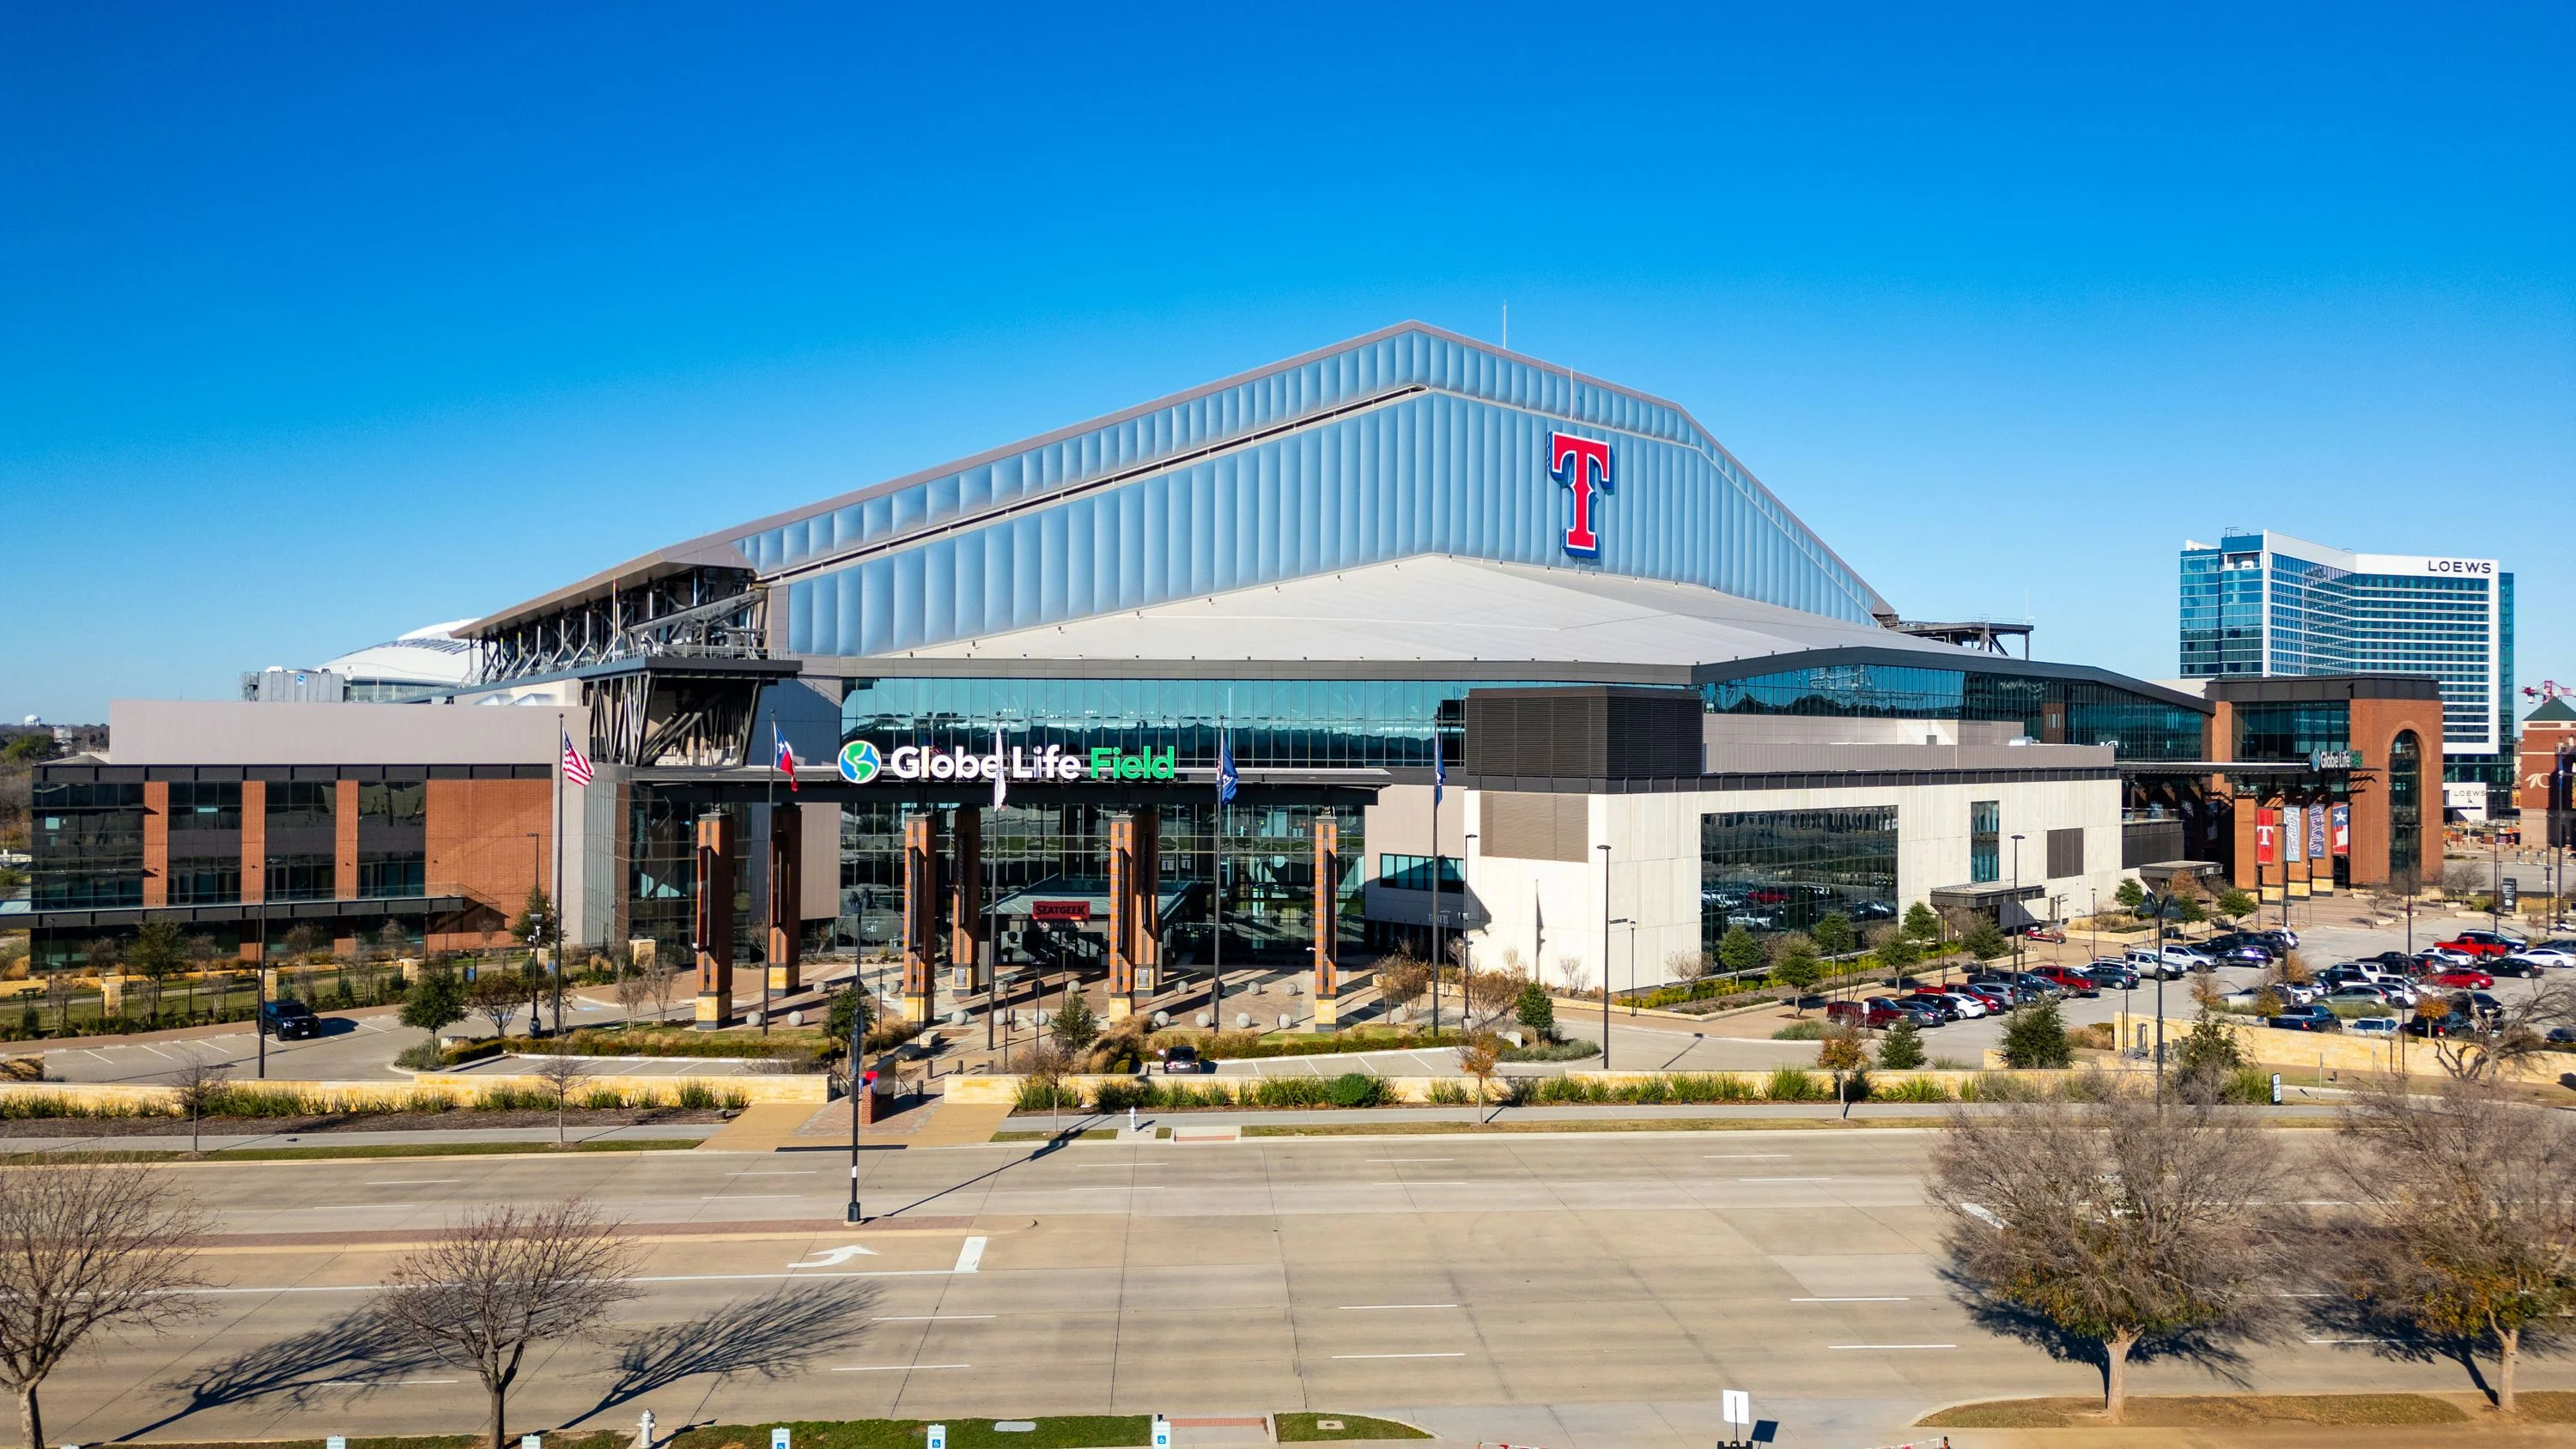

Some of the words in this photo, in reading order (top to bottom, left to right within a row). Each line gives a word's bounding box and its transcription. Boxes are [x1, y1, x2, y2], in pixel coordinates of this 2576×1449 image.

[1548, 431, 1612, 557] T
[2428, 561, 2491, 573] LOEWS
[890, 745, 999, 779] Globe
[1012, 744, 1081, 779] Life
[1091, 745, 1175, 779] Field
[2320, 751, 2339, 768] Globe
[2339, 750, 2350, 768] Life
[2257, 826, 2274, 846] T
[2309, 805, 2324, 852] TEXAS
[1036, 905, 1085, 916] SEATGEEK
[1428, 913, 1449, 925] TIKETS
